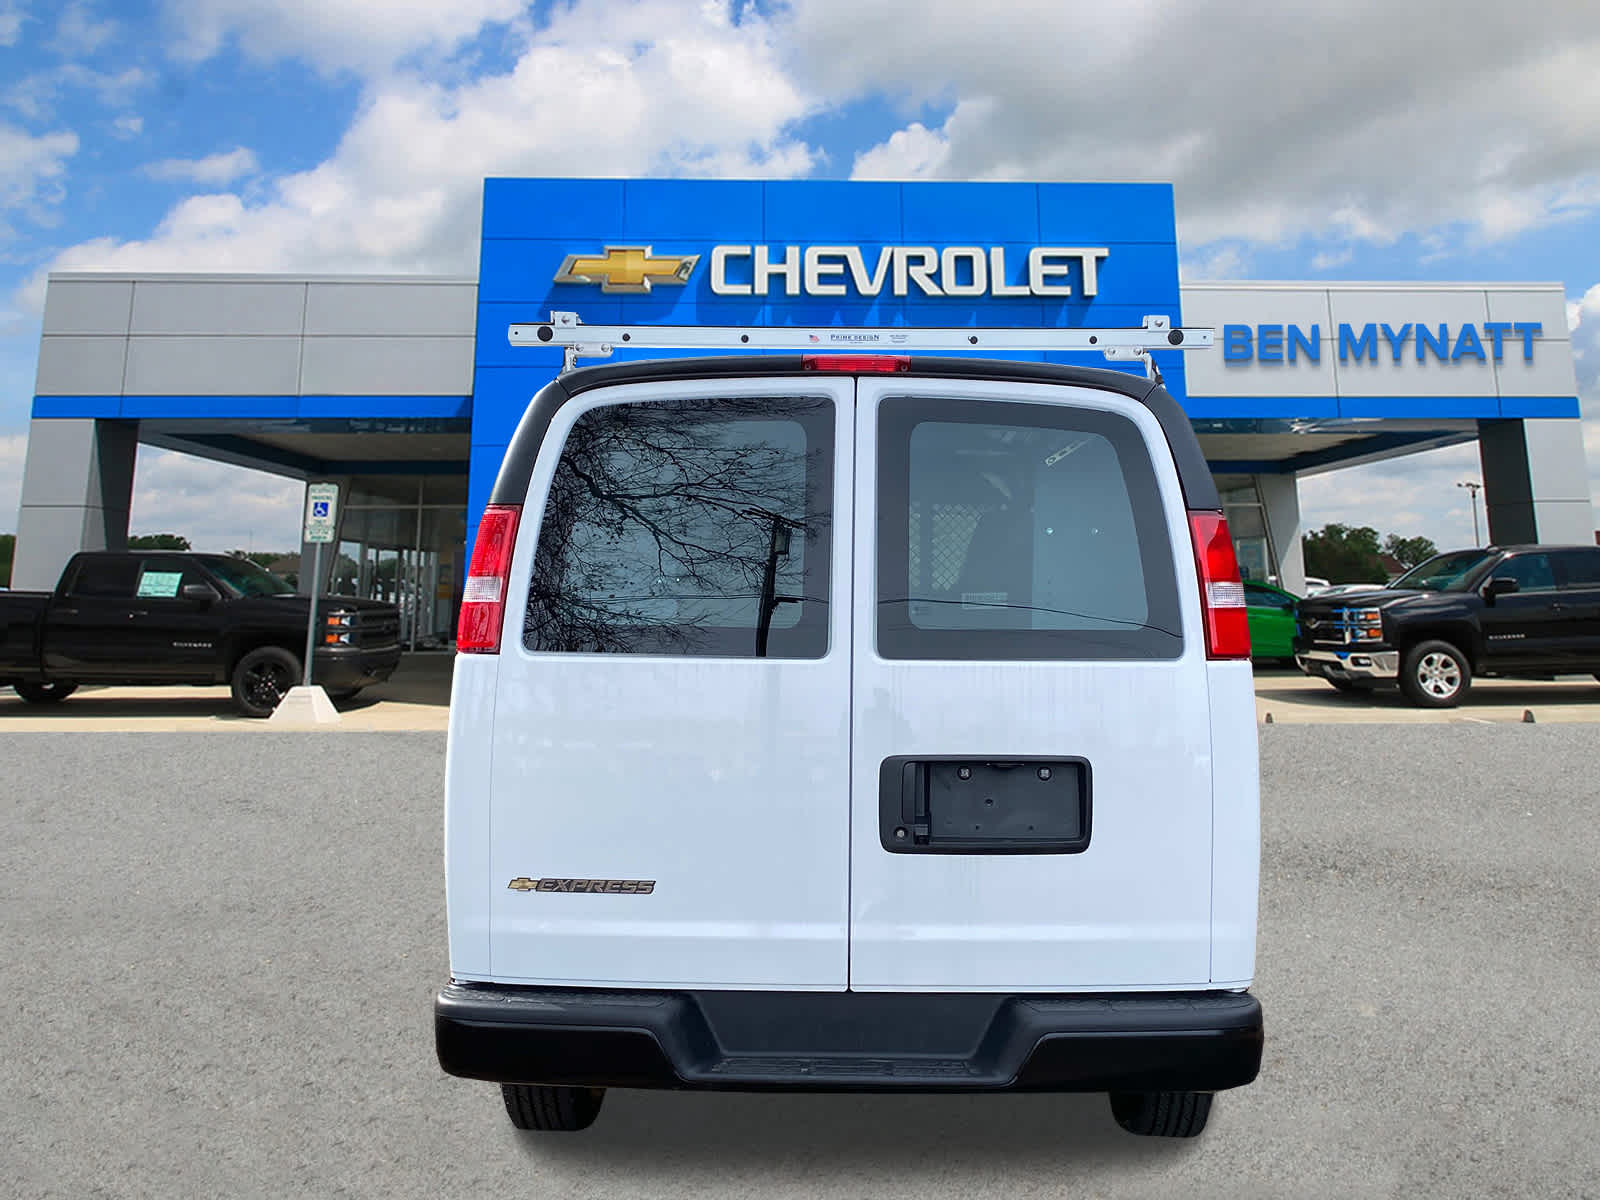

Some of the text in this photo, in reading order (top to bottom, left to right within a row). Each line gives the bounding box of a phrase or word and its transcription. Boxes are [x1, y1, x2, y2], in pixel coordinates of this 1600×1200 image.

[710, 245, 1110, 296] CHEVROLET
[1223, 322, 1543, 363] BEN MYNATT
[536, 878, 656, 895] EXPRESS
